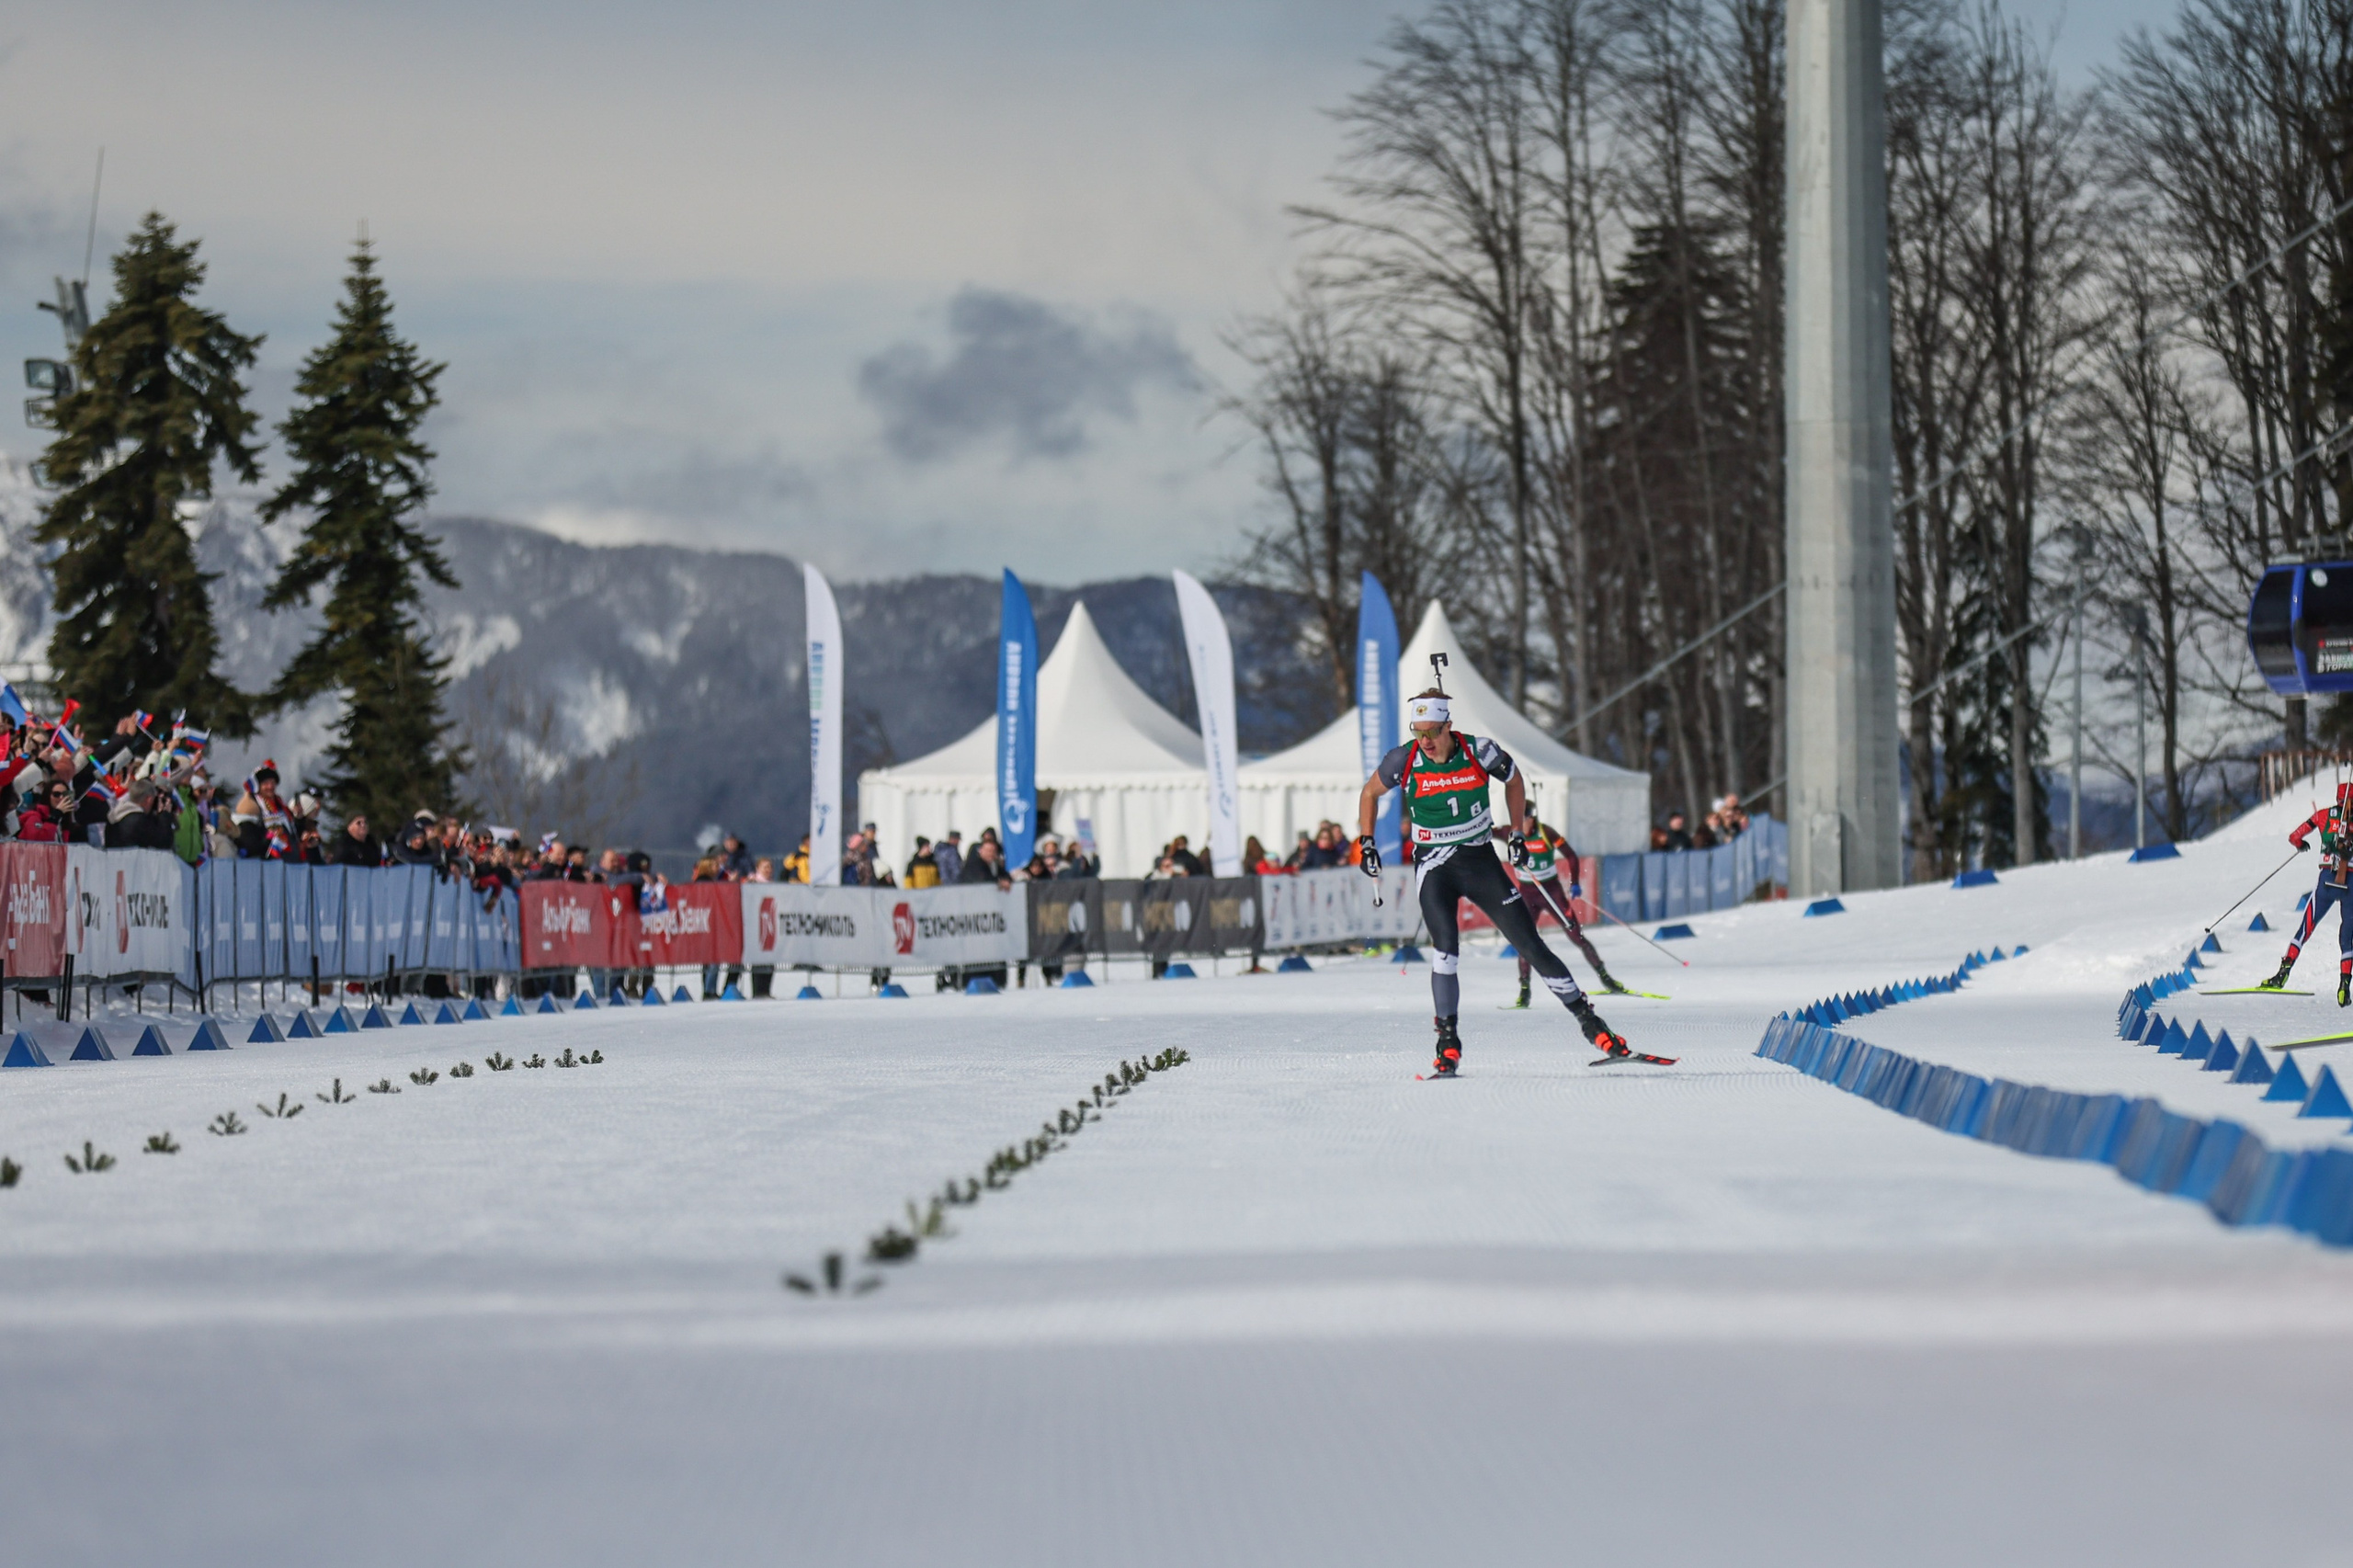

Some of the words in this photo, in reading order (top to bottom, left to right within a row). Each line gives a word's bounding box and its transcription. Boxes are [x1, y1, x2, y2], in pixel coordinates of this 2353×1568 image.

[1422, 778, 1451, 789] Альфа
[1452, 774, 1476, 785] Банк
[1447, 796, 1459, 817] 1
[677, 898, 710, 935] Банк
[916, 912, 1006, 938] ТЕХНОНИКОЛЬ
